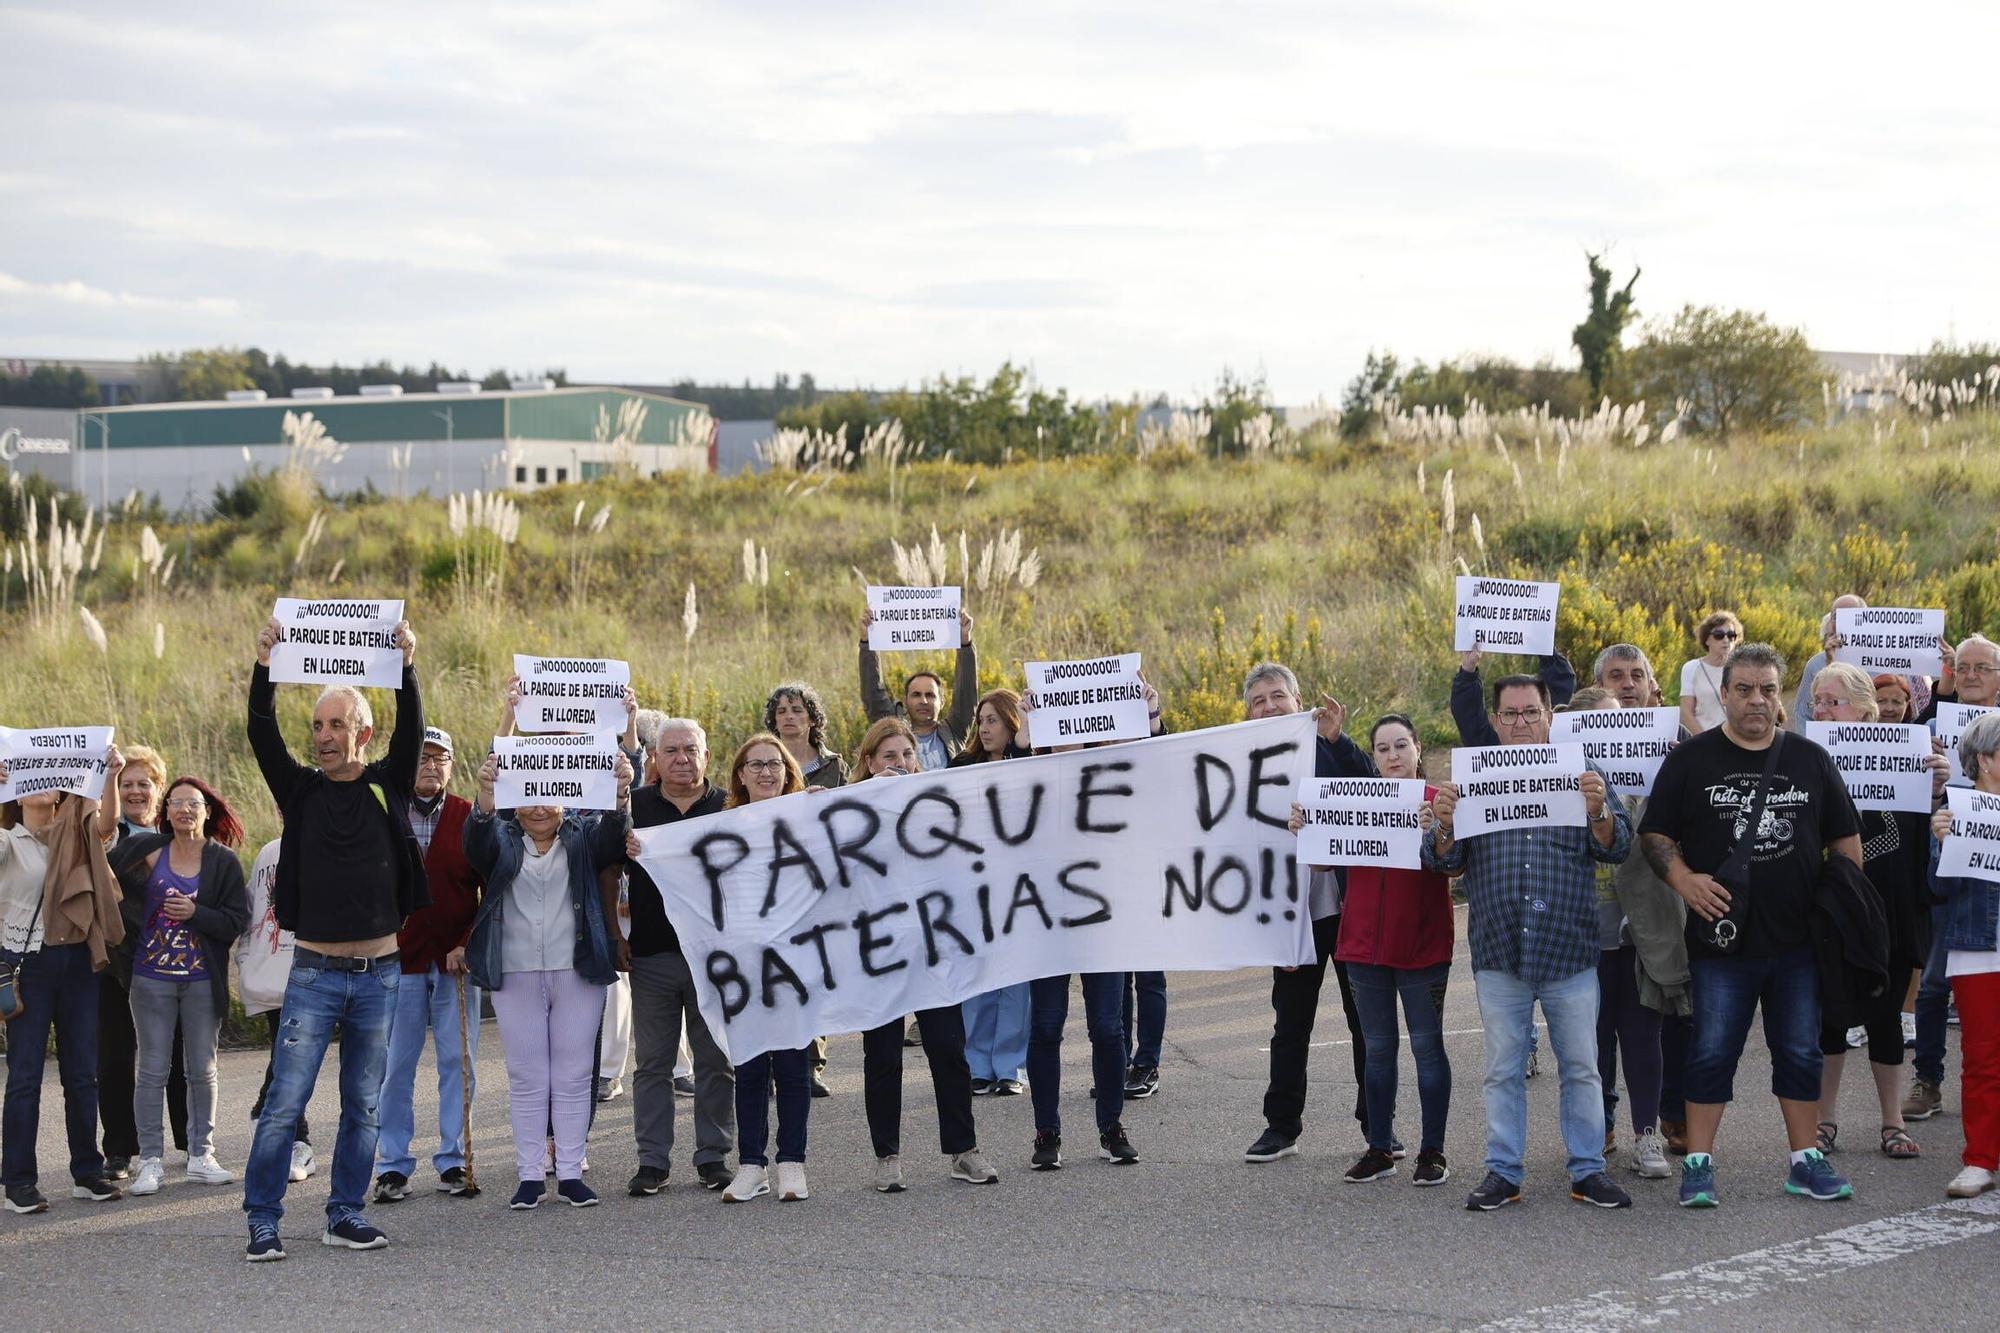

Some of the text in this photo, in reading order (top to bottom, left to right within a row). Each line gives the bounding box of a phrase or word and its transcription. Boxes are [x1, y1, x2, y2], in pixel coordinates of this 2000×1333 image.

[880, 608, 908, 621] PARQUE
[910, 608, 920, 620] DE
[1457, 604, 1466, 618] AL
[1466, 604, 1498, 620] PARQUE
[1499, 607, 1511, 621] DE
[290, 628, 330, 645] PARQUE
[333, 630, 346, 646] DE
[891, 630, 935, 643] EN LLOREDA
[1475, 629, 1524, 645] EN LLOREDA
[1851, 633, 1884, 648] PARQUE
[1886, 635, 1896, 649] DE
[303, 657, 365, 676] EN LLOREDA
[1861, 656, 1912, 669] EN LLOREDA
[531, 681, 566, 697] PARQUE
[568, 683, 580, 697] DE
[1030, 693, 1041, 709] AL
[1043, 690, 1080, 707] PARQUE
[1082, 689, 1094, 704] DE
[542, 708, 596, 724] EN LLOREDA
[1058, 715, 1116, 736] EN LLOREDA
[30, 735, 86, 749] EN LLOREDA
[1583, 742, 1607, 760] RQUE
[1610, 742, 1624, 759] DE
[44, 757, 58, 768] DE
[58, 757, 94, 770] PARQUE
[95, 758, 107, 775] AL
[497, 754, 509, 770] AL
[511, 754, 549, 771] PARQUE
[552, 755, 564, 770] DE
[1864, 755, 1878, 771] DE
[1469, 780, 1510, 797] PARQUE
[1512, 778, 1526, 794] DE
[1606, 771, 1645, 787] LOREDA
[524, 782, 583, 798] EN LLOREDA
[1705, 785, 1809, 806] Taste of reedom
[1851, 784, 1895, 800] LLOREDA
[1316, 809, 1357, 826] PARQUE
[1356, 811, 1369, 827] DE
[1485, 803, 1548, 823] EN LLOREDA
[691, 742, 1299, 931] PARQUE DE
[1950, 819, 1962, 837] AL
[1329, 839, 1388, 857] EN LLOREDA
[1968, 852, 1984, 868] EN
[1162, 847, 1298, 925] NO!!
[143, 948, 204, 970] YORK
